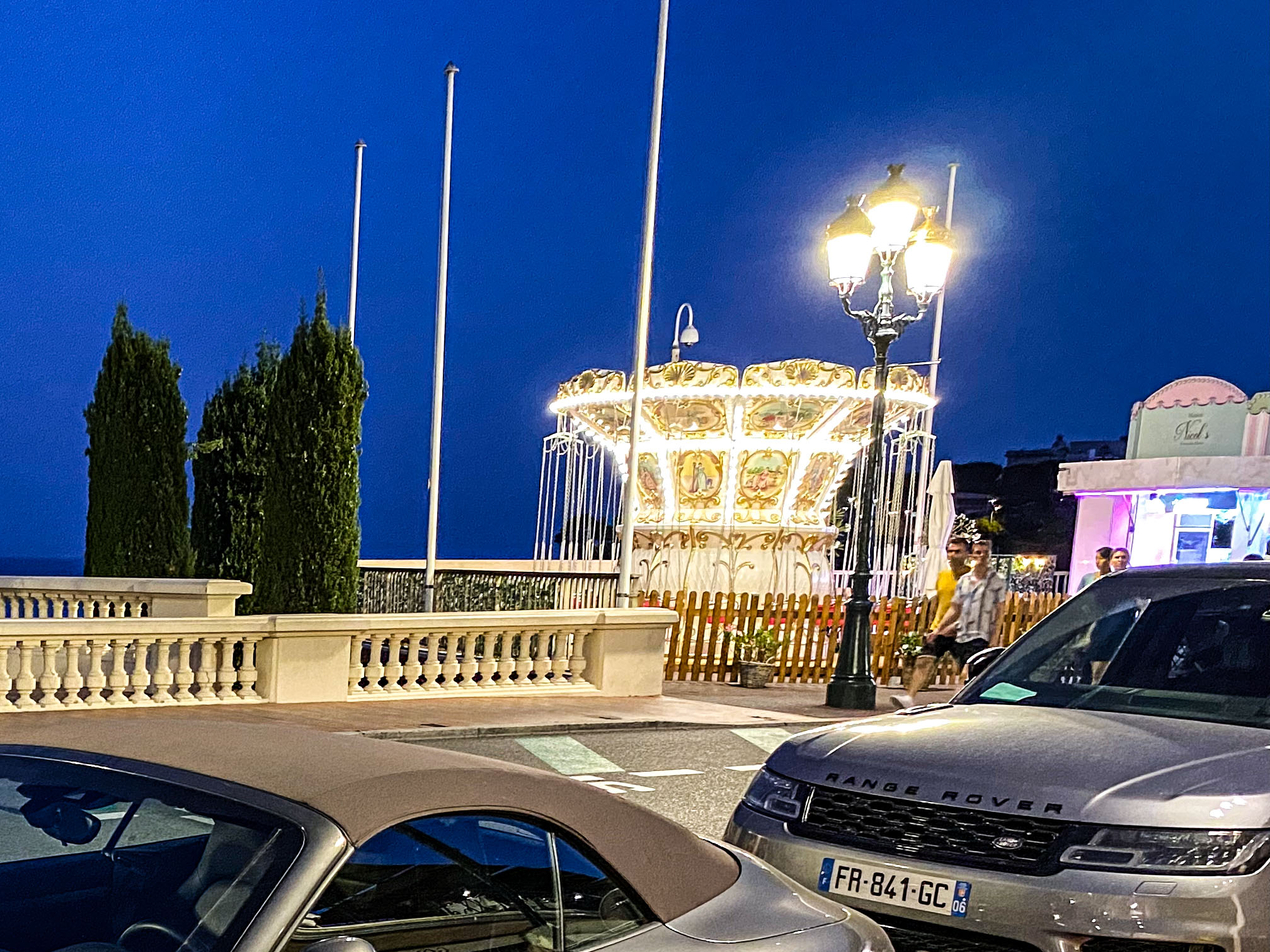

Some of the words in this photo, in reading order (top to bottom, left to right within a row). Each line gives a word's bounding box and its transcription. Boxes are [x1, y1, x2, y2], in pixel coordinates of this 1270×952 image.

[825, 772, 920, 795] RANGE
[941, 790, 1063, 814] ROVER
[835, 865, 949, 908] FR-841-GC
[952, 900, 966, 914] 06
